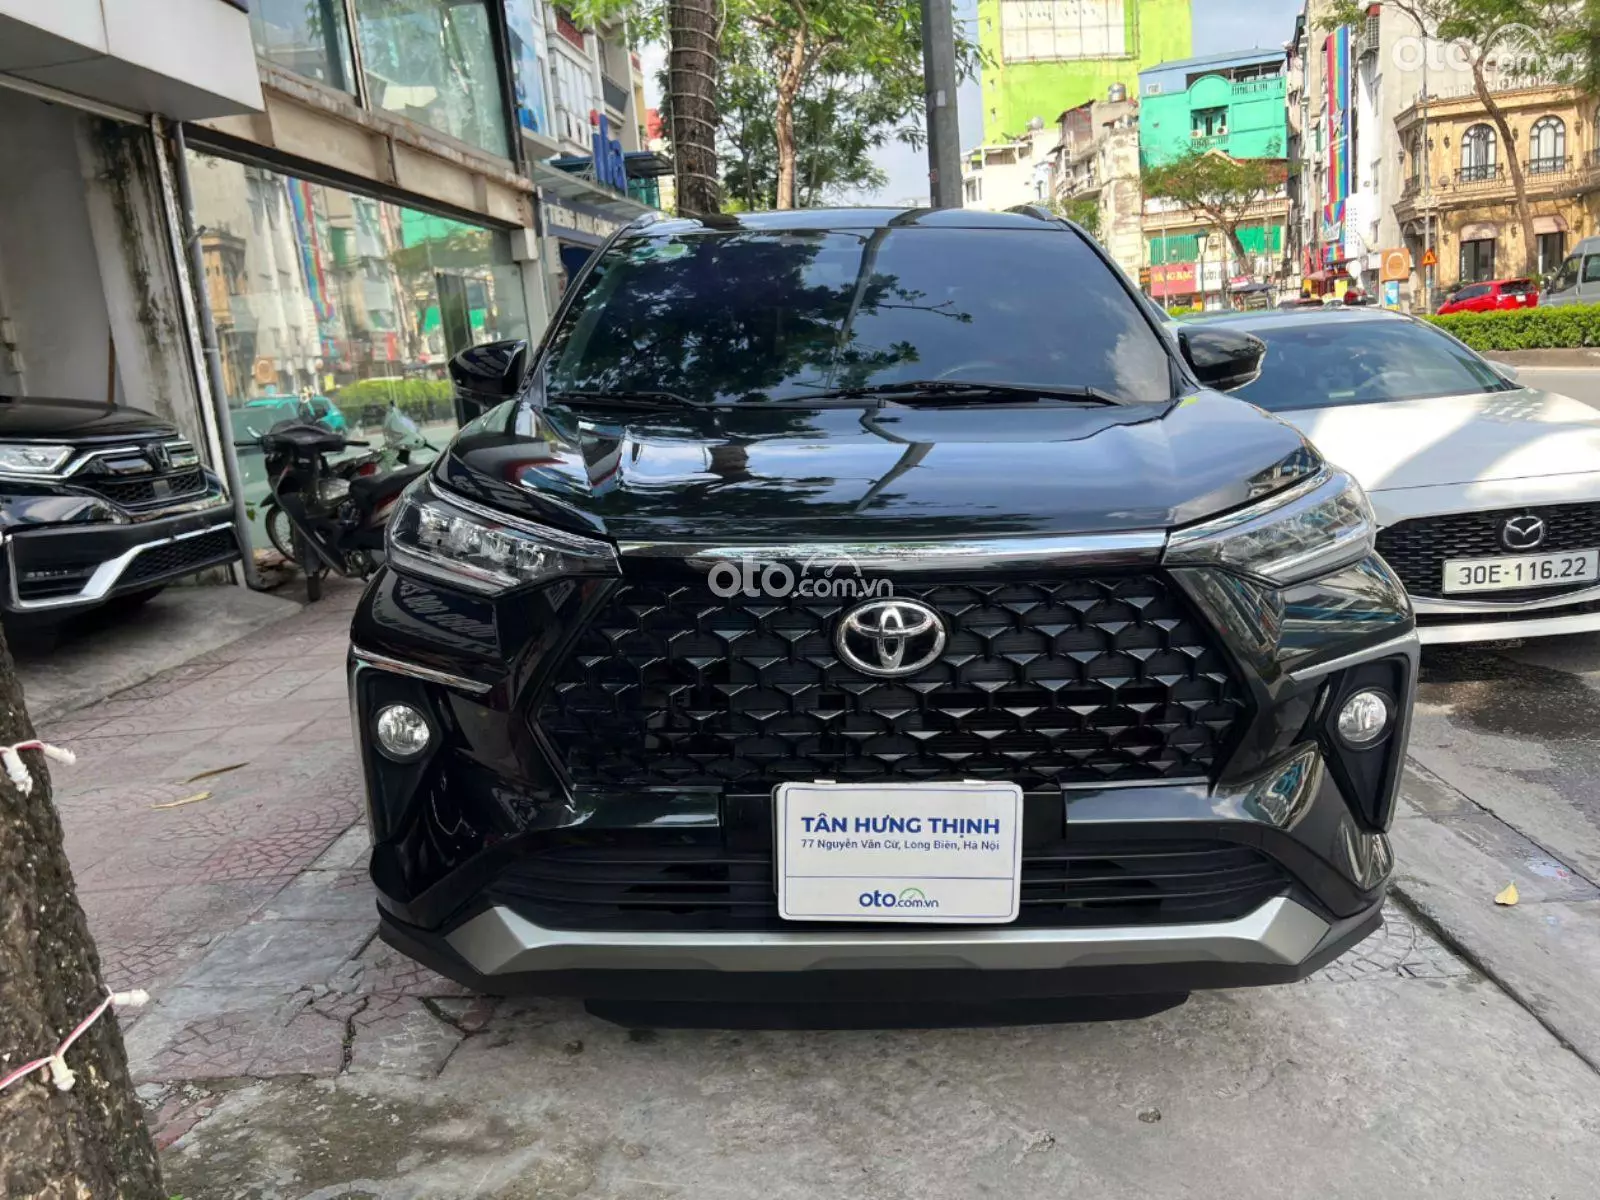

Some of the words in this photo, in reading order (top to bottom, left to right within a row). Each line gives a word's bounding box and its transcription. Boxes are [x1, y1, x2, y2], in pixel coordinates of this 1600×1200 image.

[1458, 557, 1586, 585] 30E-116.22
[801, 812, 847, 833] TÂN
[855, 814, 921, 833] HƯNG
[928, 818, 1000, 838] THỊNH
[801, 839, 814, 849] 77
[904, 840, 931, 851] Long
[964, 840, 977, 850] Hà
[981, 840, 1000, 851] Nội
[859, 890, 939, 907] oto.com.vn
